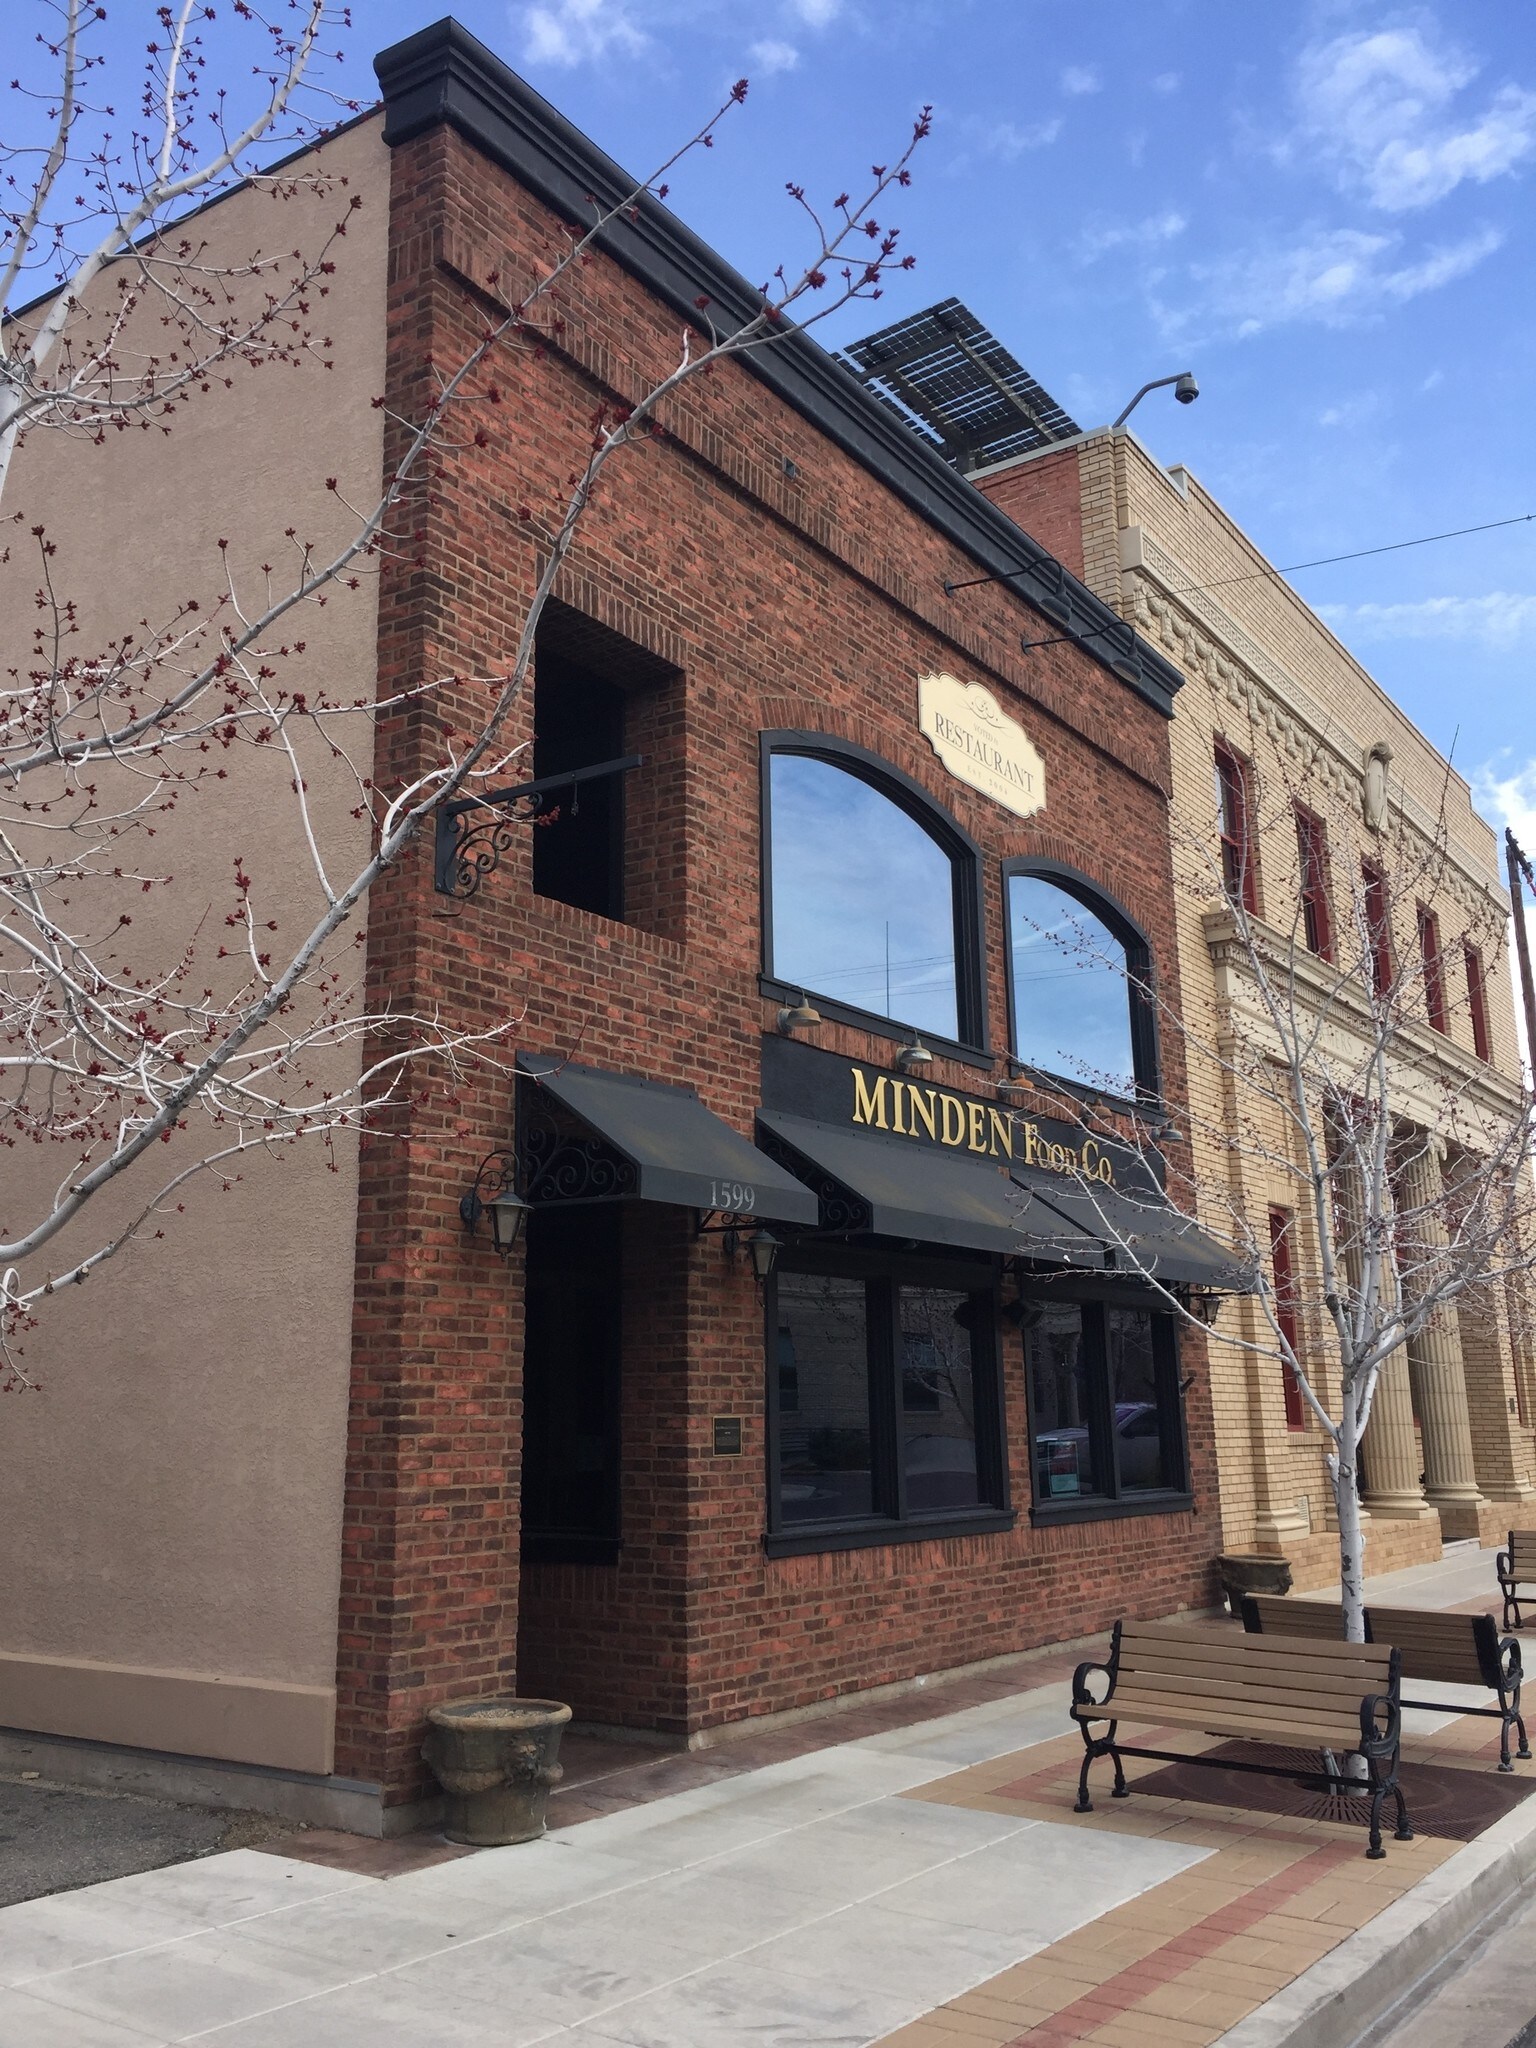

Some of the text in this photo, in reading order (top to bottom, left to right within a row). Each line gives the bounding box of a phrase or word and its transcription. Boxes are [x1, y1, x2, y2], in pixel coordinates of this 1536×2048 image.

[935, 711, 1034, 793] RESTAURANT
[851, 1068, 1013, 1159] MINDEN
[710, 1181, 755, 1211] 1599
